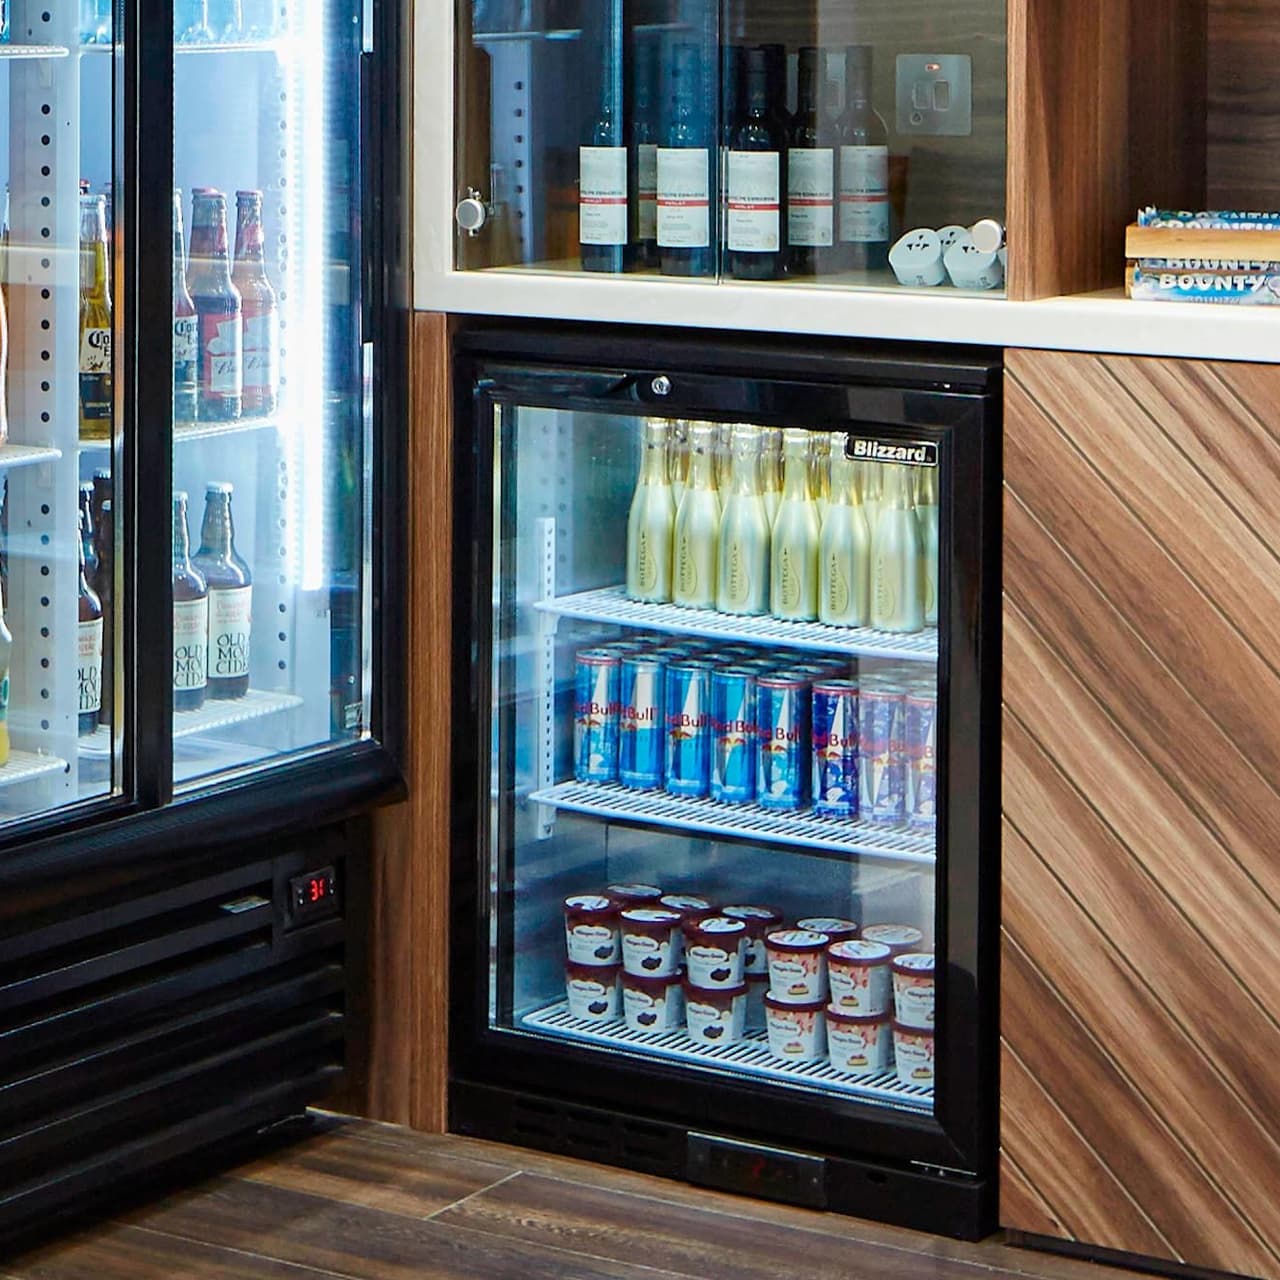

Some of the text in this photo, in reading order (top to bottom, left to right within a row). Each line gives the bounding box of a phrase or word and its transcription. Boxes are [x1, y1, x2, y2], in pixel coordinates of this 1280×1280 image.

[1160, 274, 1267, 292] BOUNTY
[853, 440, 927, 462] Blizzard
[217, 632, 246, 647] OLD
[175, 644, 203, 659] OLD
